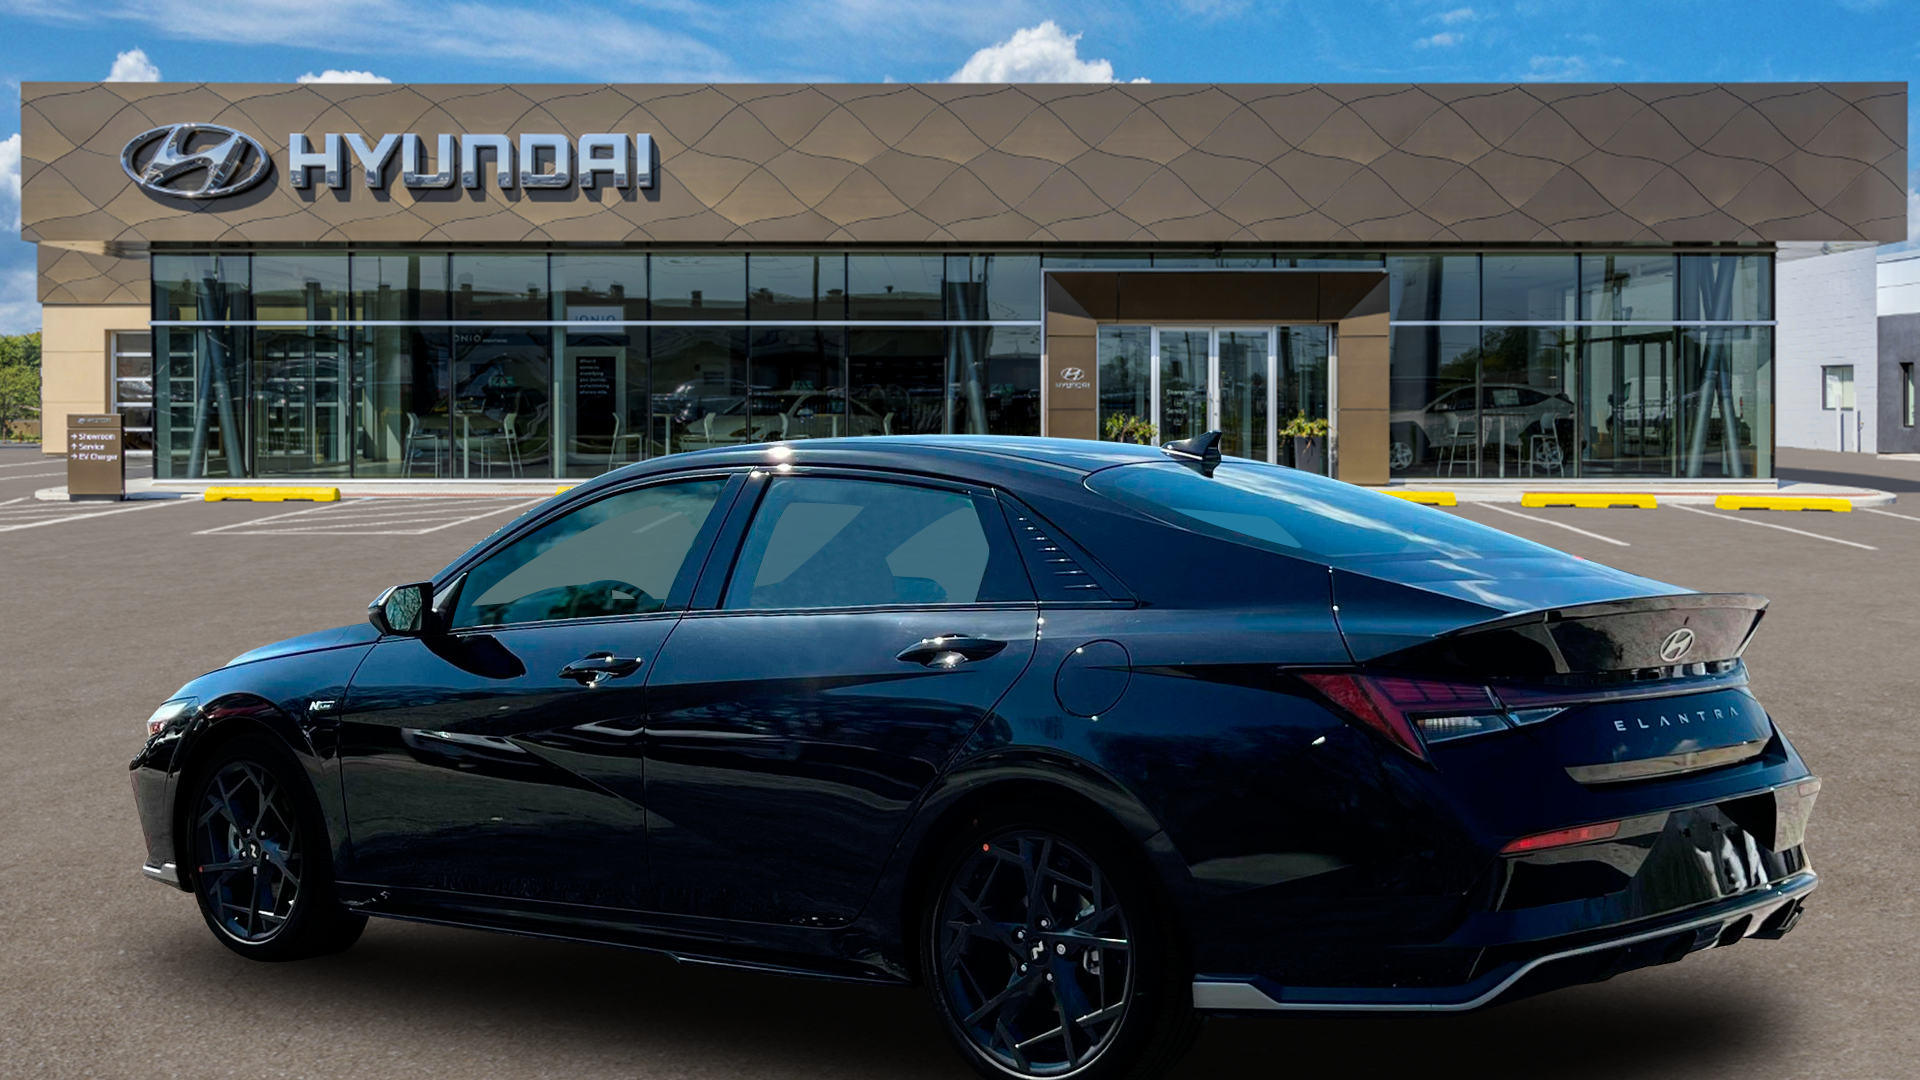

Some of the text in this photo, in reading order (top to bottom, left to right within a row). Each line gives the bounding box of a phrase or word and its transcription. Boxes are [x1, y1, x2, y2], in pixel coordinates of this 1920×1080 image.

[289, 133, 655, 189] HYUNDAI
[78, 433, 116, 441] Showroom
[78, 443, 105, 451] Service
[90, 453, 118, 462] Charger
[1613, 706, 1740, 732] ELANTRA
